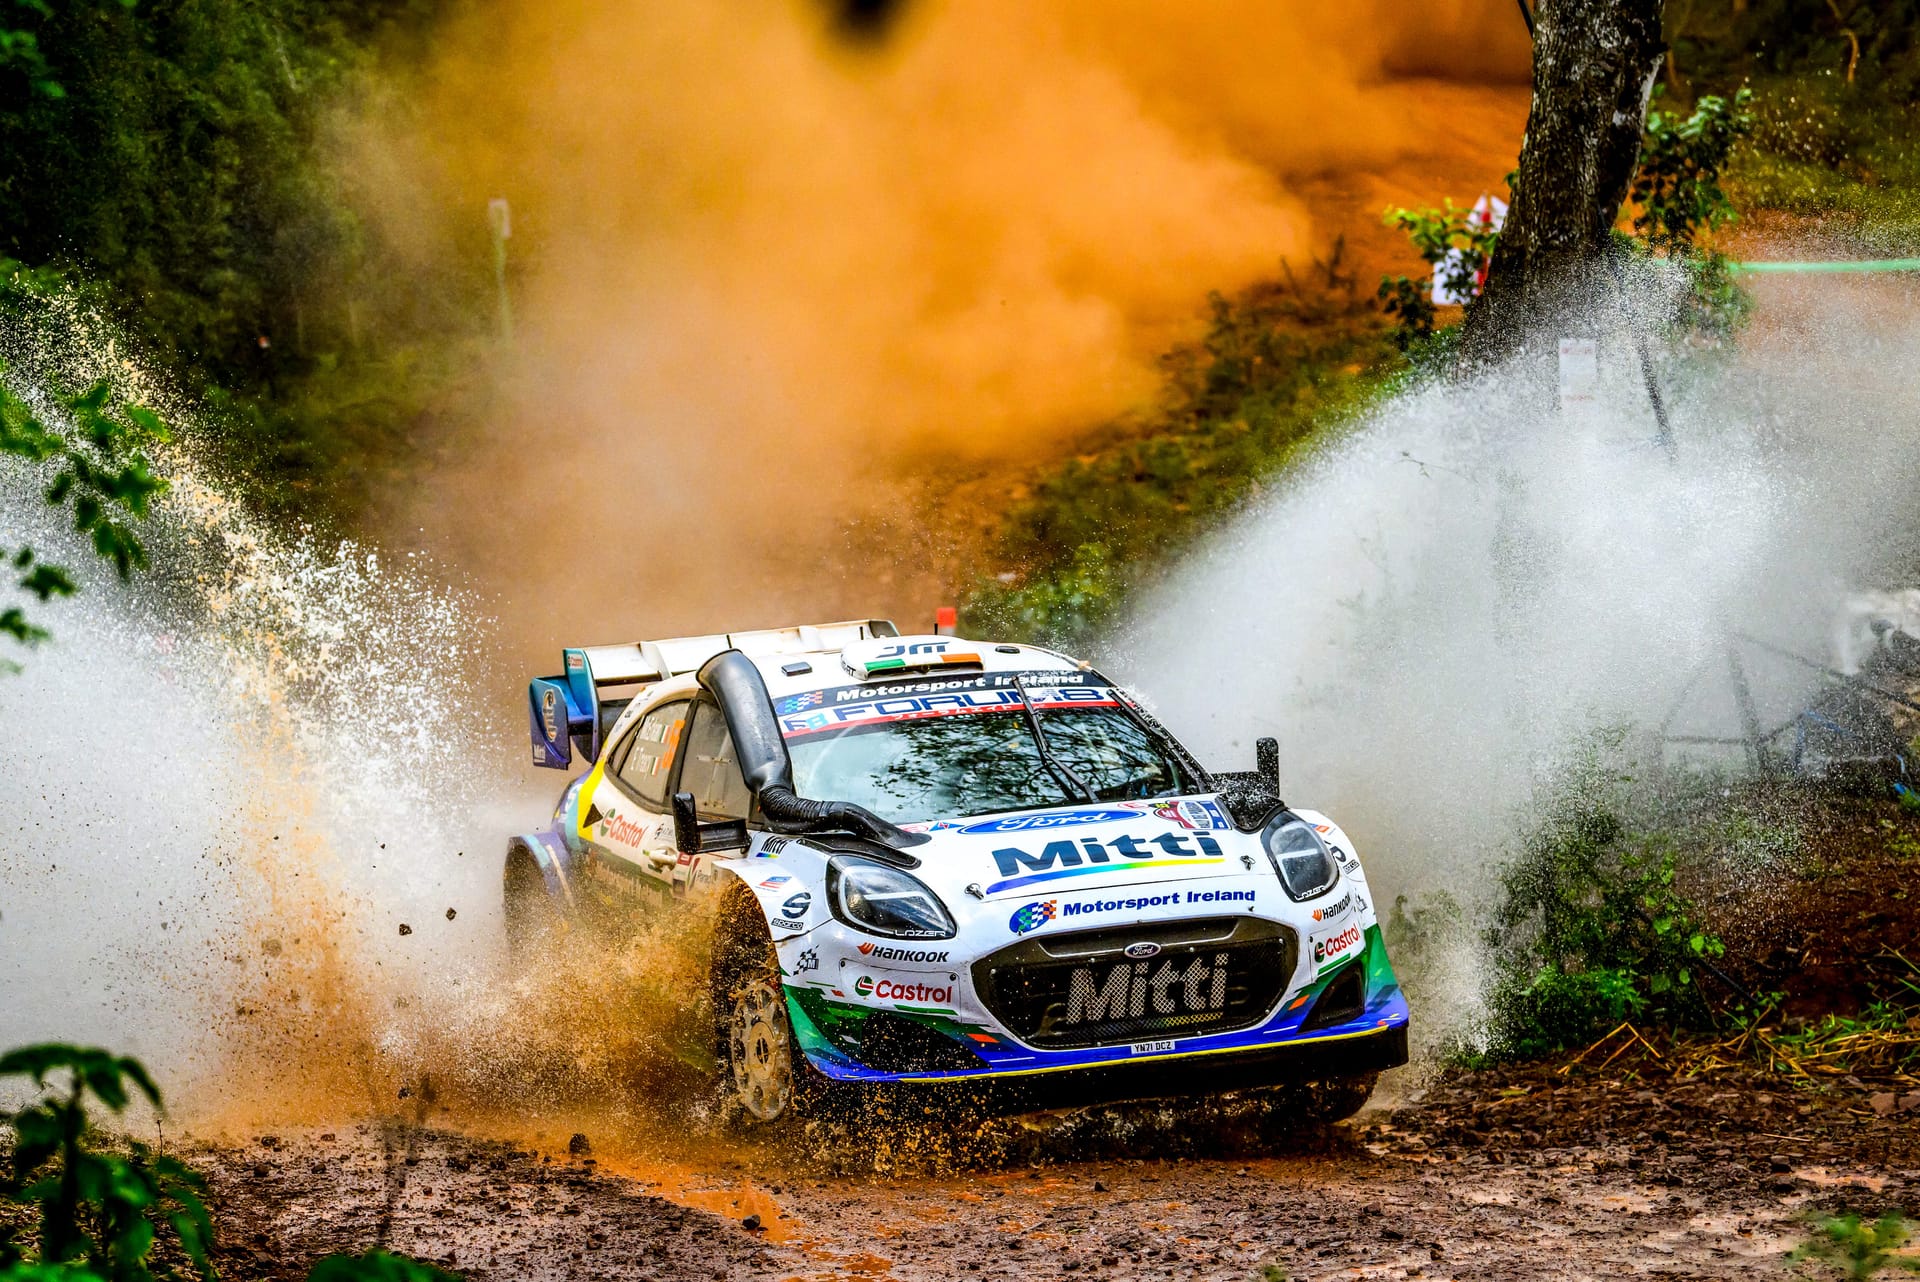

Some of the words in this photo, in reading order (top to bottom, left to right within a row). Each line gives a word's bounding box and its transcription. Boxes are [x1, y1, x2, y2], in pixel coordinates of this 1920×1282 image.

[836, 674, 986, 702] Motorsport
[994, 674, 1084, 691] Ireland
[609, 814, 649, 849] Castrol
[997, 811, 1112, 830] Ford
[992, 831, 1224, 878] Mitti
[1063, 891, 1181, 917] Motorsport
[1186, 890, 1256, 904] Ireland
[1132, 944, 1155, 956] Ford
[1325, 923, 1361, 957] Castrol
[875, 979, 953, 1004] Castrol
[1066, 952, 1230, 1025] Mitti
[1134, 1042, 1153, 1053] YN71
[1155, 1041, 1171, 1051] DCZ
